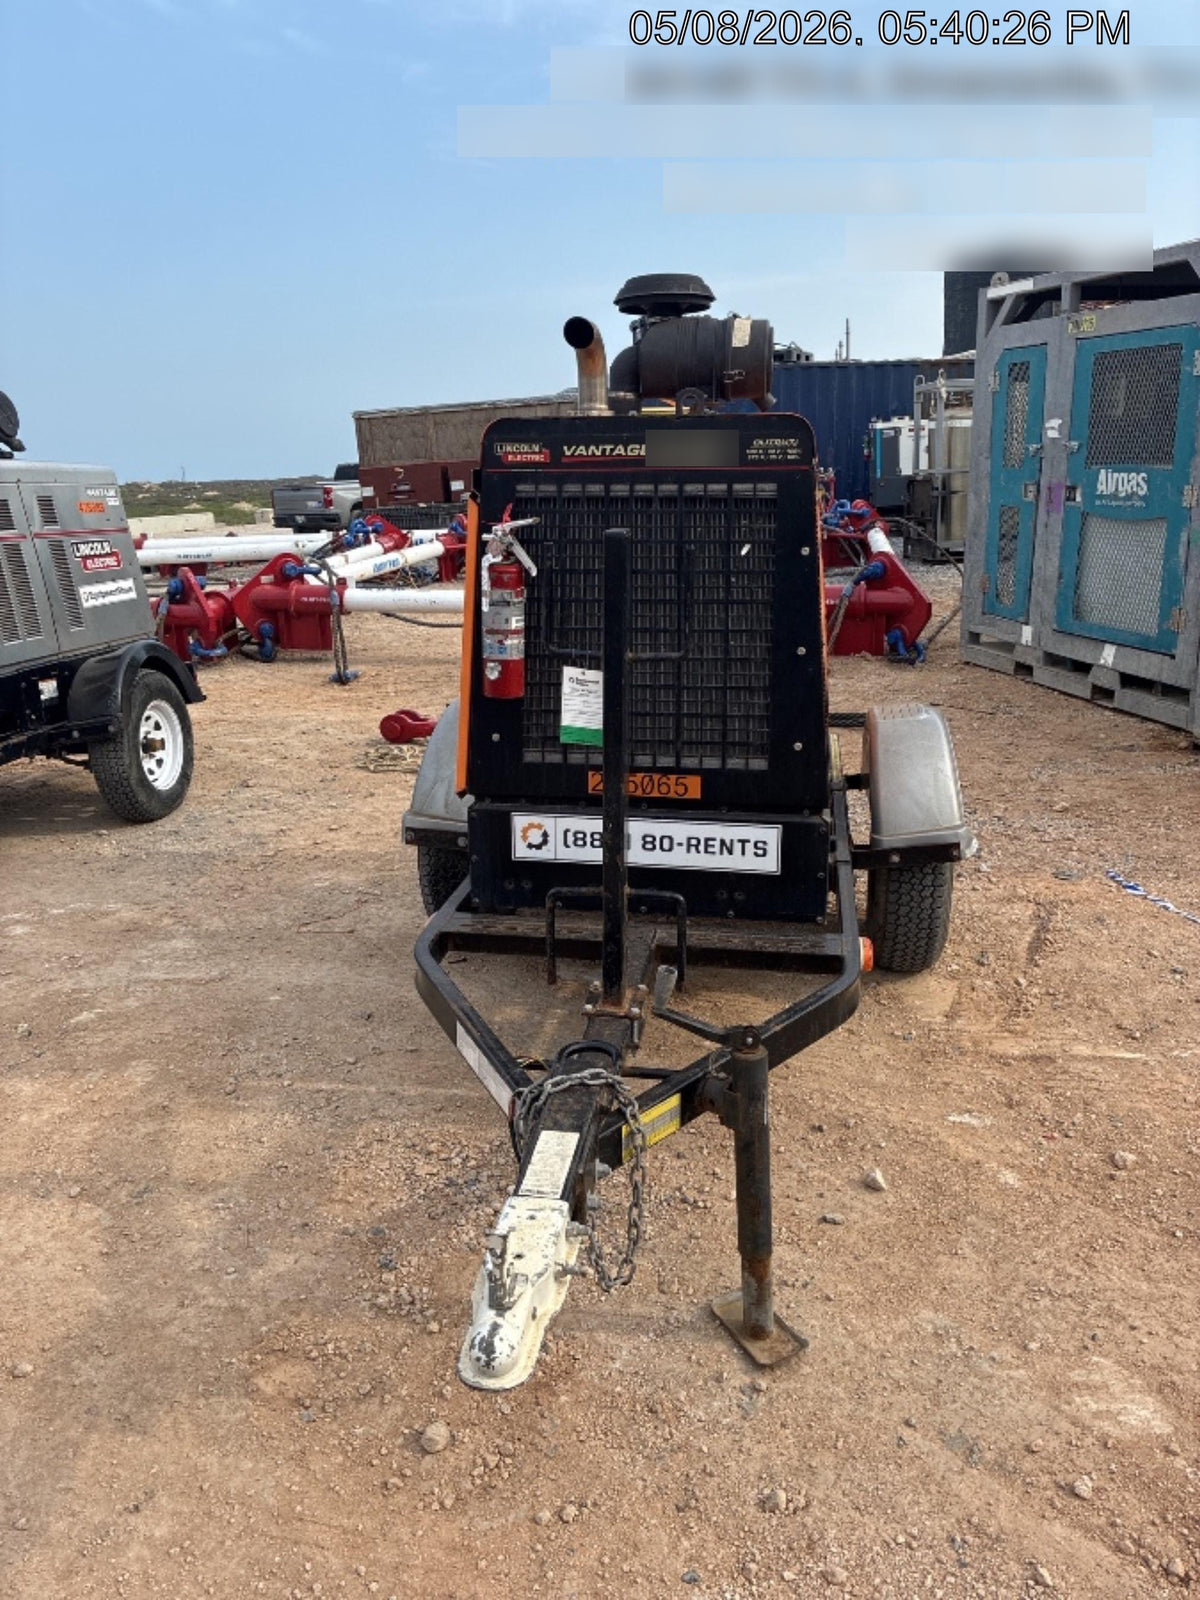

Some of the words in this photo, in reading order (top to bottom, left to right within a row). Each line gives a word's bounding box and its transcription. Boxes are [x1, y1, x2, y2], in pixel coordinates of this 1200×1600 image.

[496, 443, 540, 453] LINCOLN
[507, 454, 546, 462] ELECTRIC
[1095, 469, 1148, 497] Airgas
[75, 543, 112, 557] LINCOLN
[86, 556, 119, 569] ELECTRIC
[590, 772, 689, 797] 25065
[563, 828, 631, 851] (88)
[641, 833, 768, 858] 80-RENTS
